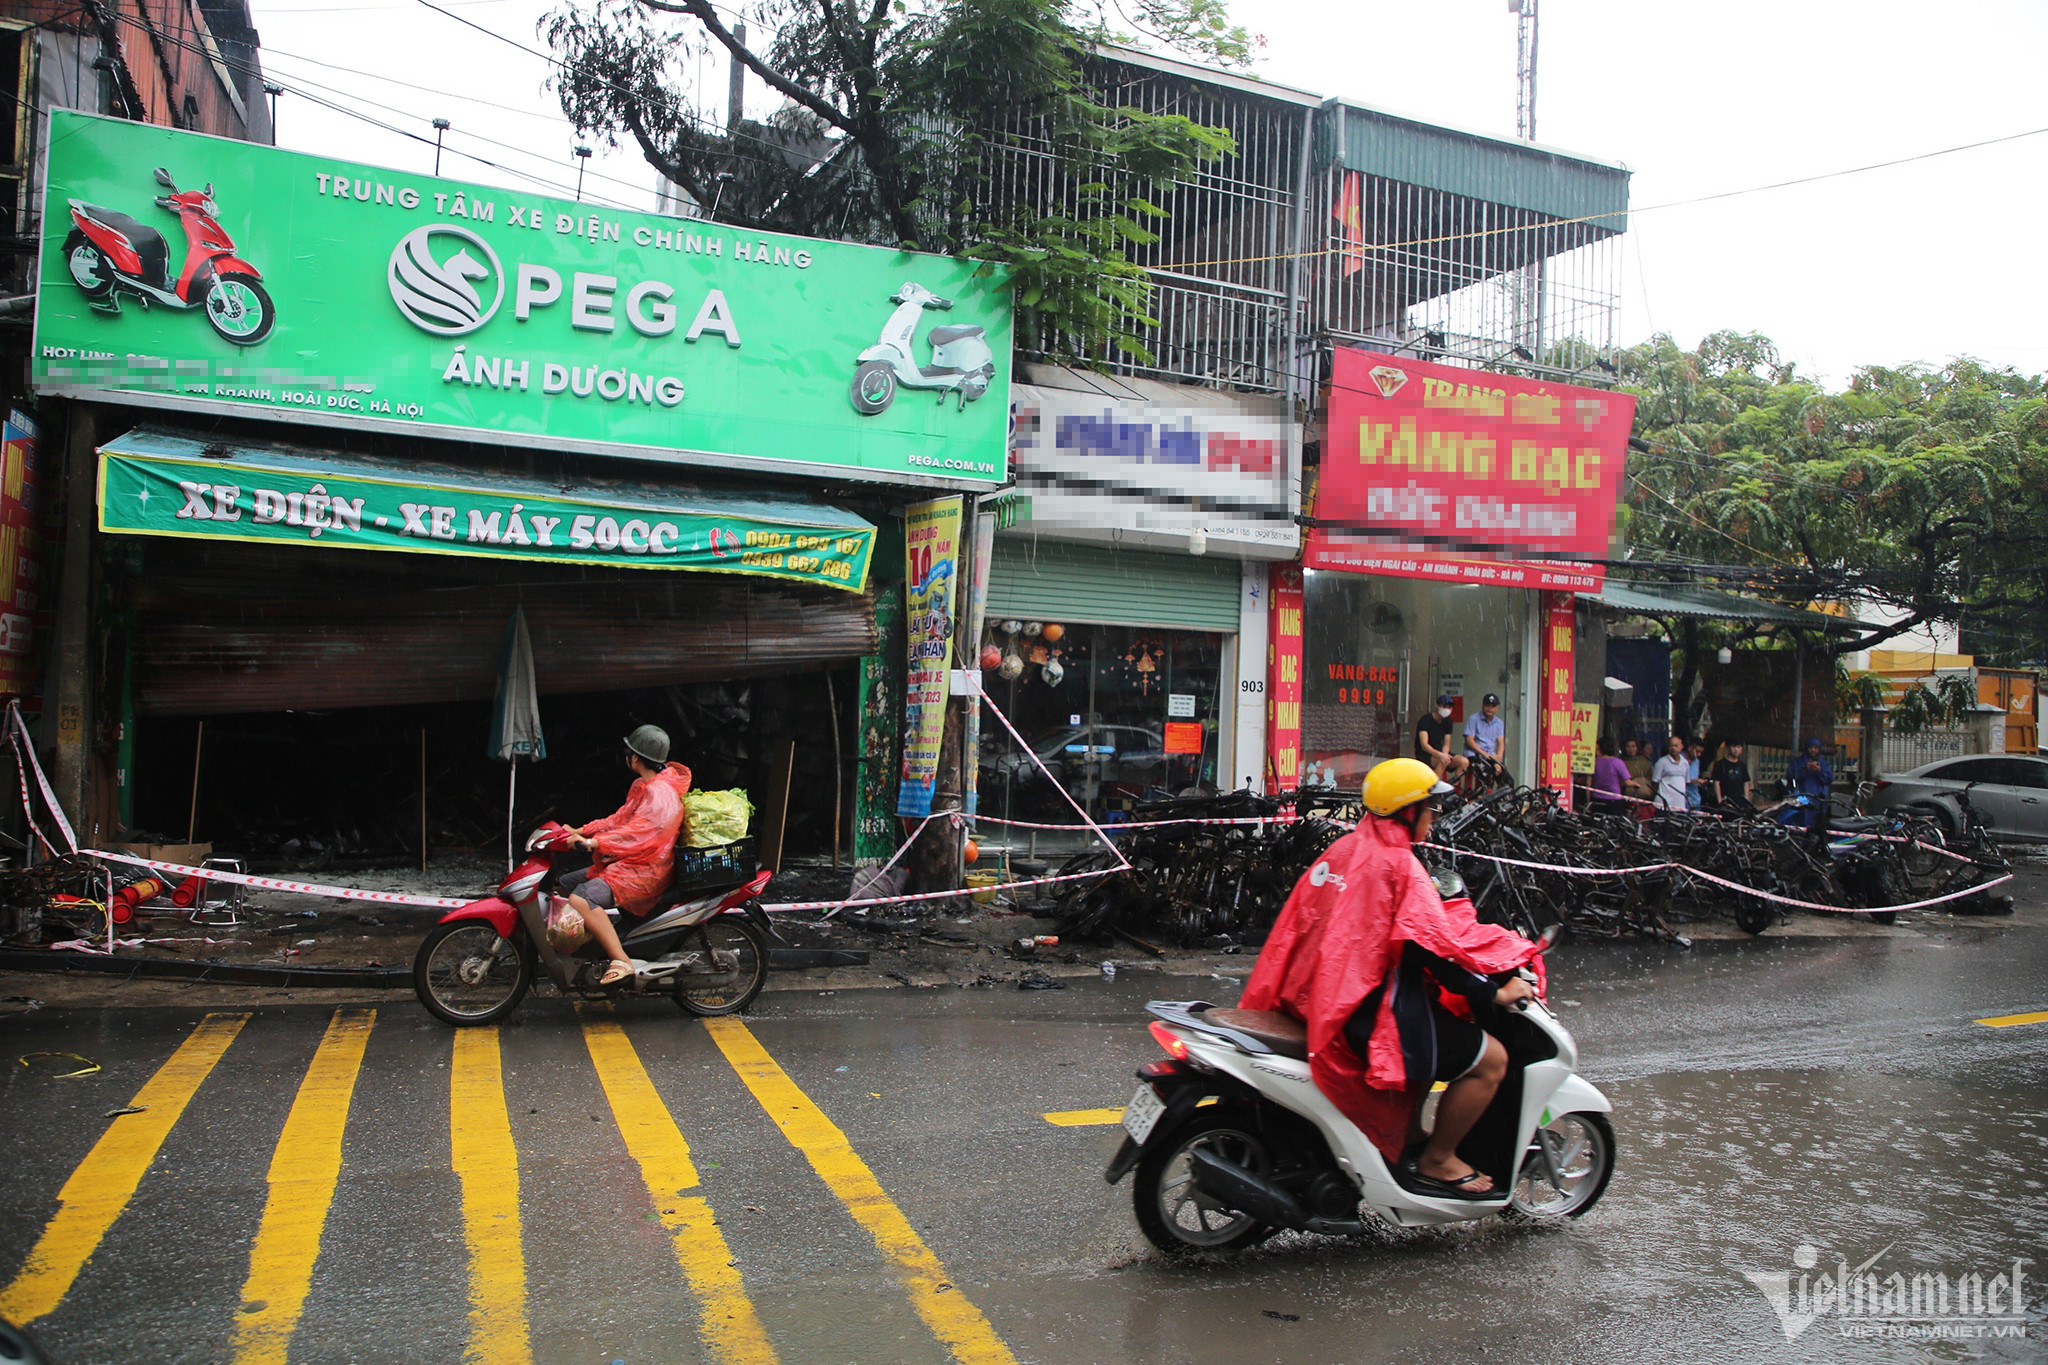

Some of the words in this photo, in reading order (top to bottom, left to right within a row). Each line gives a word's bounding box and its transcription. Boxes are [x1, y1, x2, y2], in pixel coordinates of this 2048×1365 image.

[316, 172, 420, 209] TRUNG
[433, 190, 495, 224] TÂM
[508, 204, 544, 230] XE
[555, 214, 621, 245] ĐIỆN
[632, 224, 724, 257] CHÍNH
[733, 238, 814, 269] HÃNG
[514, 261, 743, 349] PEGA
[442, 343, 529, 393] ÁNH
[542, 362, 686, 409] DƯƠNG
[281, 389, 321, 406] HOÀI
[326, 395, 365, 412] ĐỨC,
[369, 401, 391, 414] HÀ
[396, 404, 425, 419] NỘI
[907, 453, 995, 474] PEGA.COM.VN
[175, 480, 242, 523] XE
[252, 483, 366, 538] ĐIỆN
[397, 502, 457, 539] XE
[465, 503, 561, 547] MÁY
[569, 514, 680, 555] 50CC
[745, 530, 791, 549] 0904
[834, 537, 864, 556] 167
[787, 554, 820, 573] 662
[1279, 601, 1301, 636] VÀNG
[1553, 620, 1572, 652] VÀNG
[1241, 680, 1264, 693] 903
[1281, 654, 1297, 689] BẠC
[1554, 668, 1569, 700] BẠC
[1279, 740, 1296, 777] CƯỚI
[1551, 745, 1568, 779] CƯỚI
